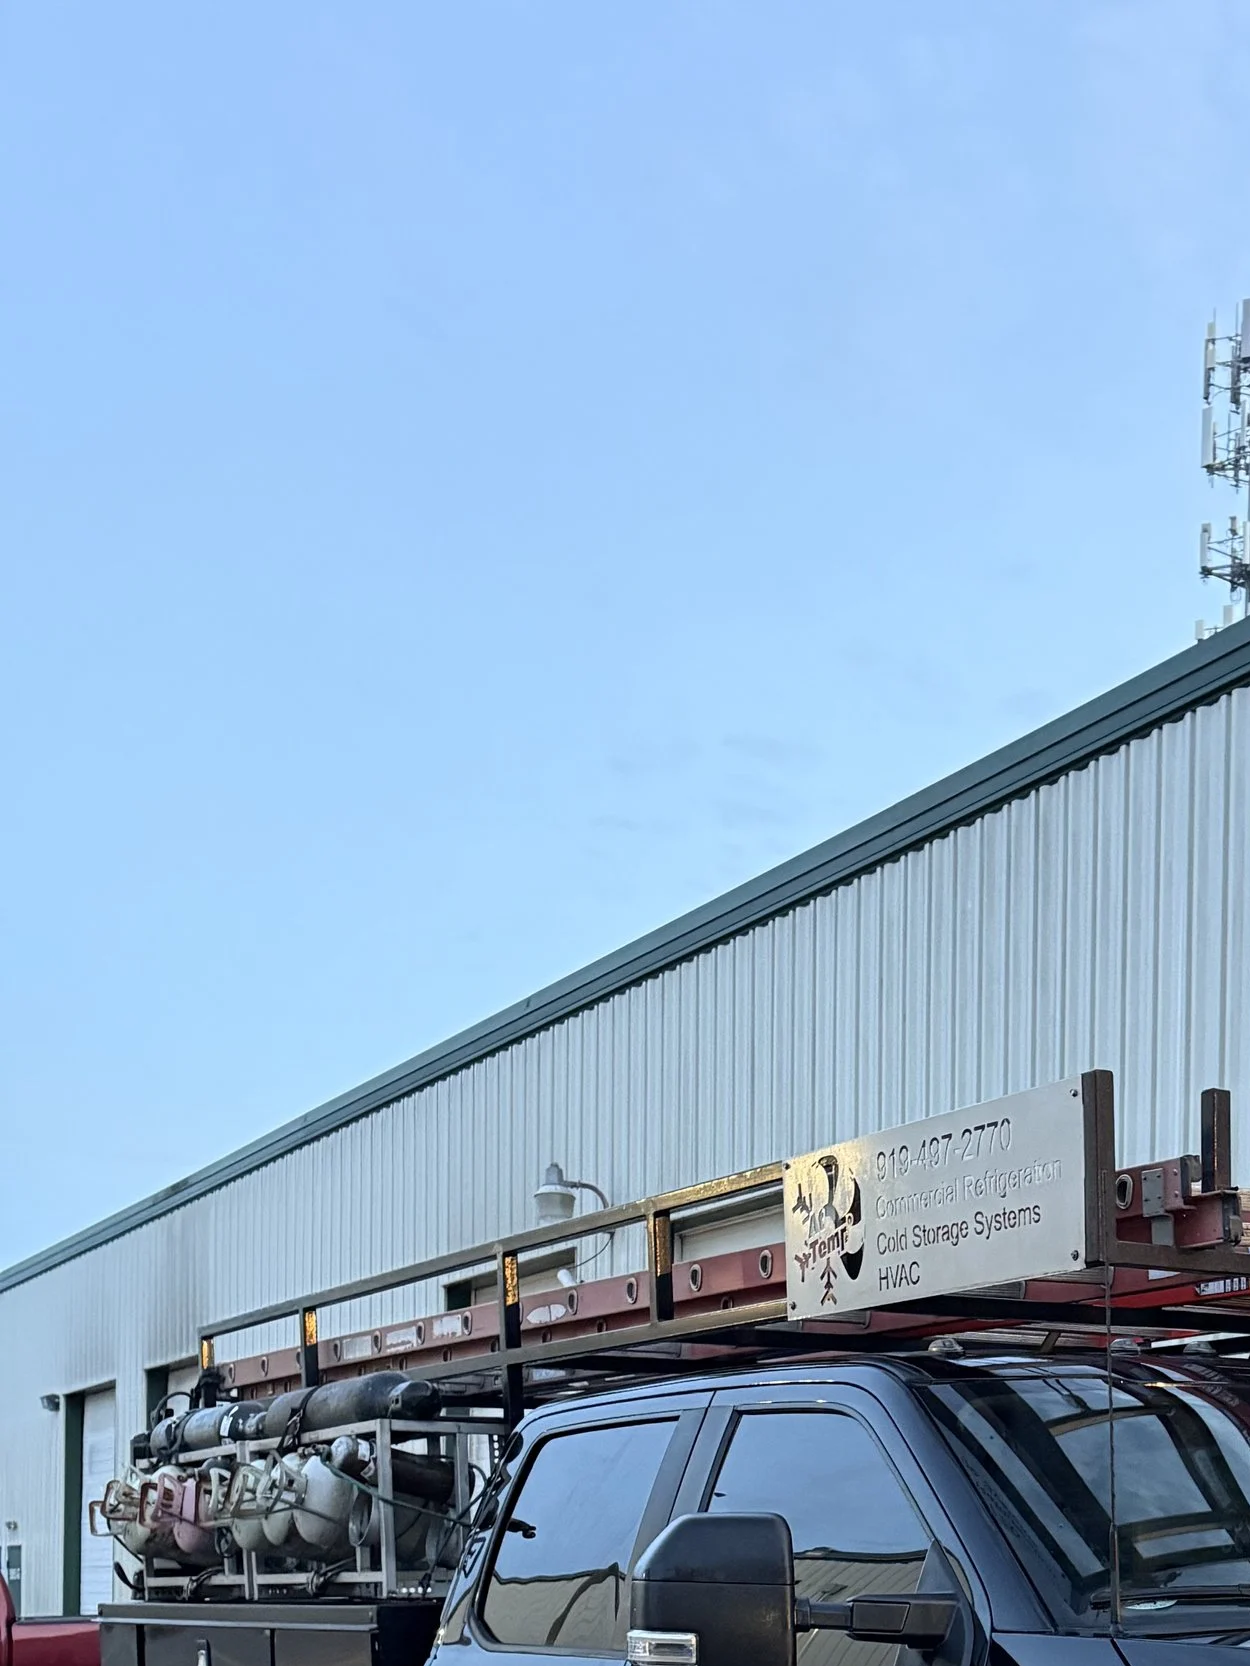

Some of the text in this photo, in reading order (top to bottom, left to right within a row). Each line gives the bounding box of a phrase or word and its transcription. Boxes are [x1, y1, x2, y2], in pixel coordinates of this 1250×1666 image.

[876, 1117, 1012, 1182] 919-497-2770
[875, 1158, 1063, 1220] Commercial Refrigeration
[876, 1204, 1042, 1256] Cold Storage Systems
[878, 1261, 921, 1292] HVAC
